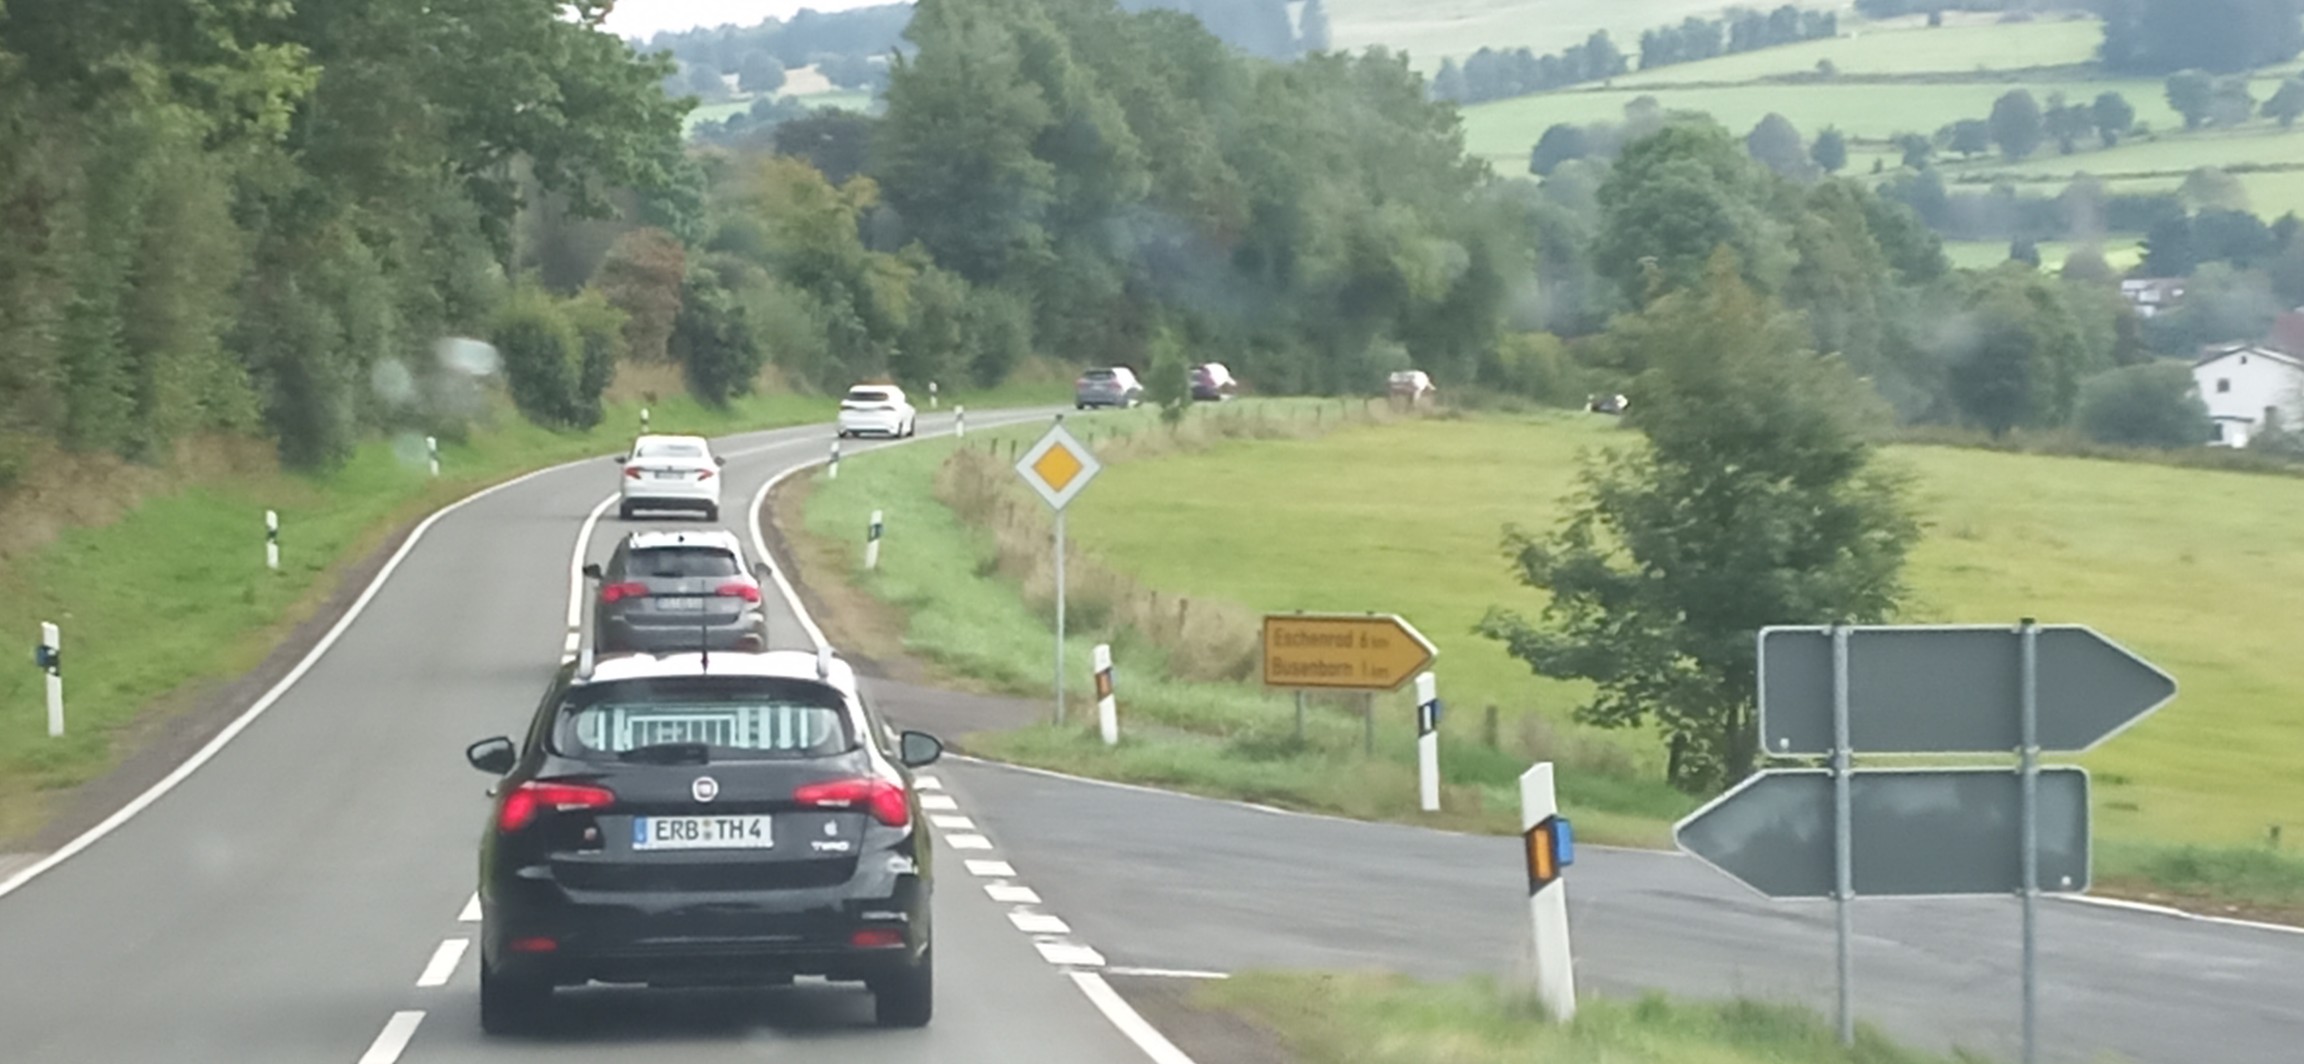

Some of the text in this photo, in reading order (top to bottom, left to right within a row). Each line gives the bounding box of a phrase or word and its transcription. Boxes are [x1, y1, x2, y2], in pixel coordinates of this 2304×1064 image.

[1273, 627, 1354, 648] Eschenrod
[1371, 635, 1390, 648] km
[1272, 656, 1354, 677] Busenborn
[1371, 663, 1390, 678] km
[655, 819, 700, 841] ERB
[715, 819, 744, 840] TH
[748, 818, 762, 839] 4
